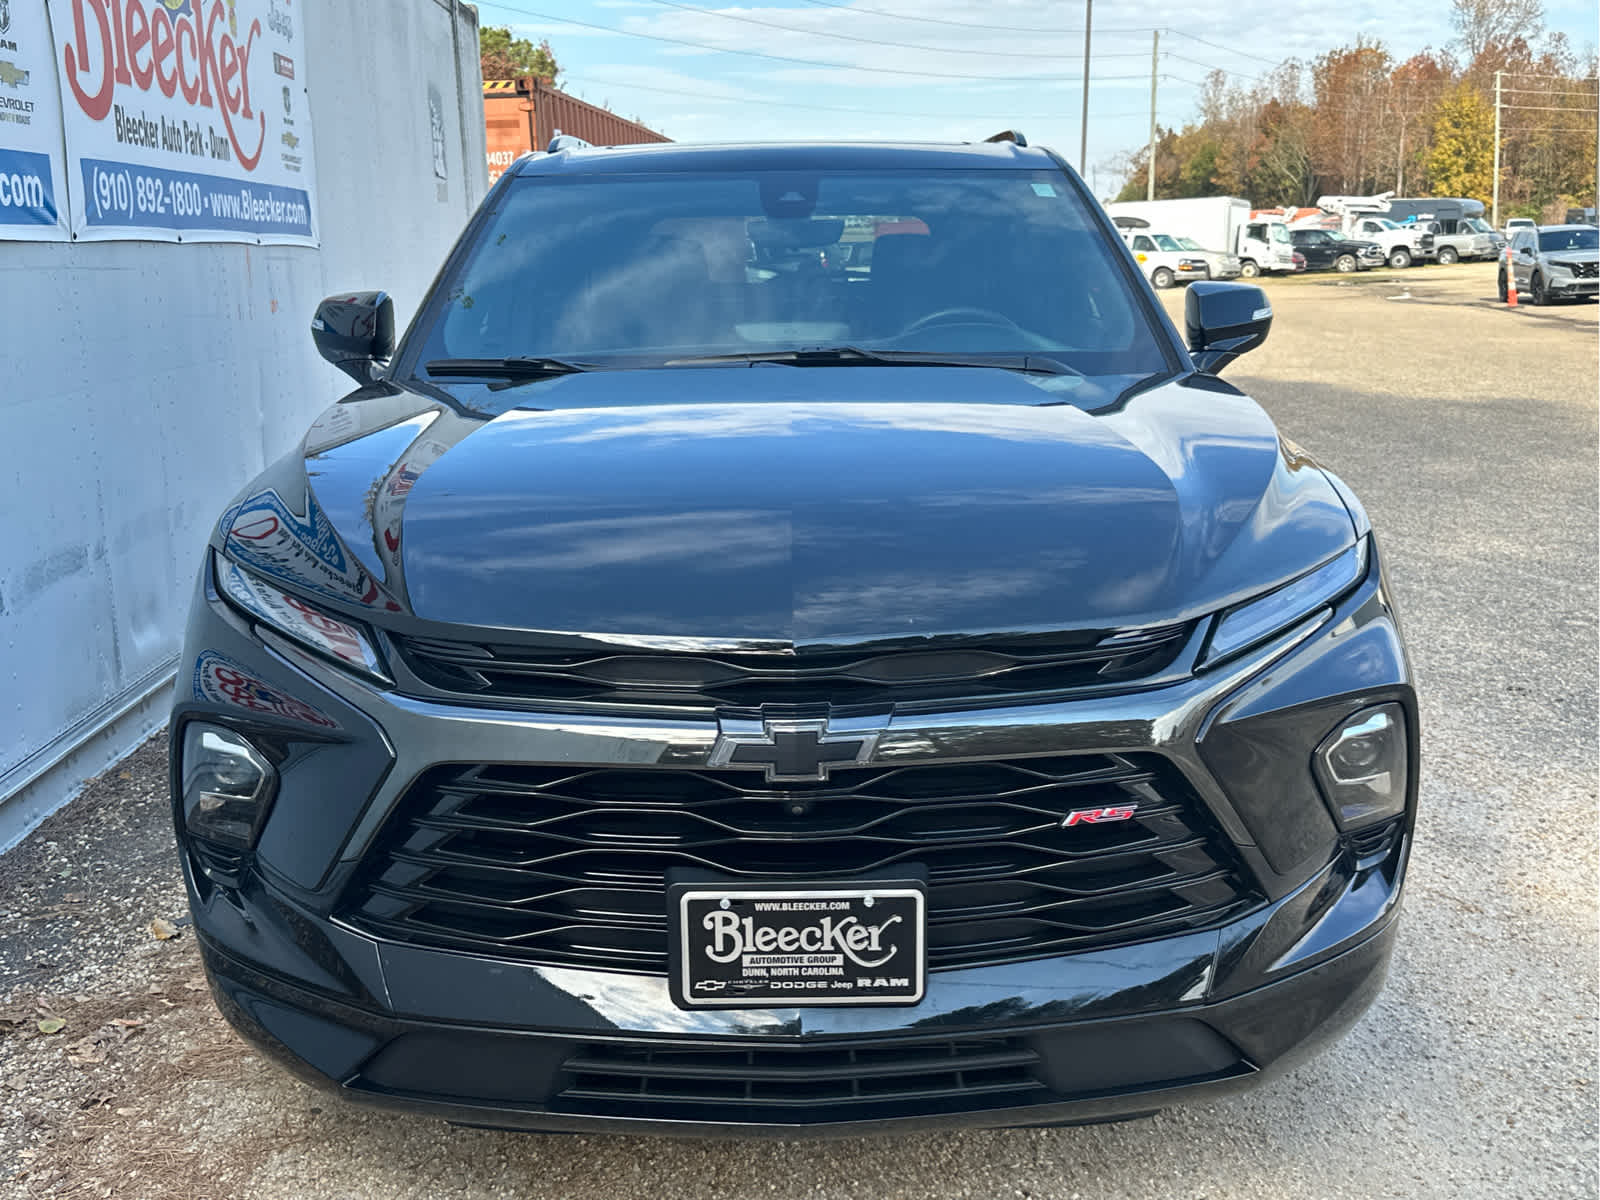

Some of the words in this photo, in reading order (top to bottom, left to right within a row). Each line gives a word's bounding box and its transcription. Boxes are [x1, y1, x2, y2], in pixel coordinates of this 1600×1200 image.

[114, 104, 159, 149] Bleecker
[161, 115, 183, 154] Auto
[183, 120, 205, 158] Park
[209, 126, 231, 161] Dunn
[93, 167, 134, 220] (910)
[136, 175, 202, 217] 892-1800
[209, 189, 308, 225] www.Bleecker.com
[1062, 804, 1138, 827] RS
[755, 902, 850, 911] WWW.BLEECKER.COM
[703, 910, 902, 968] Bleecker
[749, 955, 805, 965] AUTOMOTIVE
[807, 955, 837, 965] GROUP
[742, 967, 769, 978] DUNN,
[771, 967, 799, 977] NORTH
[801, 967, 844, 976] CAROLINA
[770, 981, 828, 989] DODGE
[831, 981, 853, 990] Jeep
[857, 978, 909, 987] RAM
